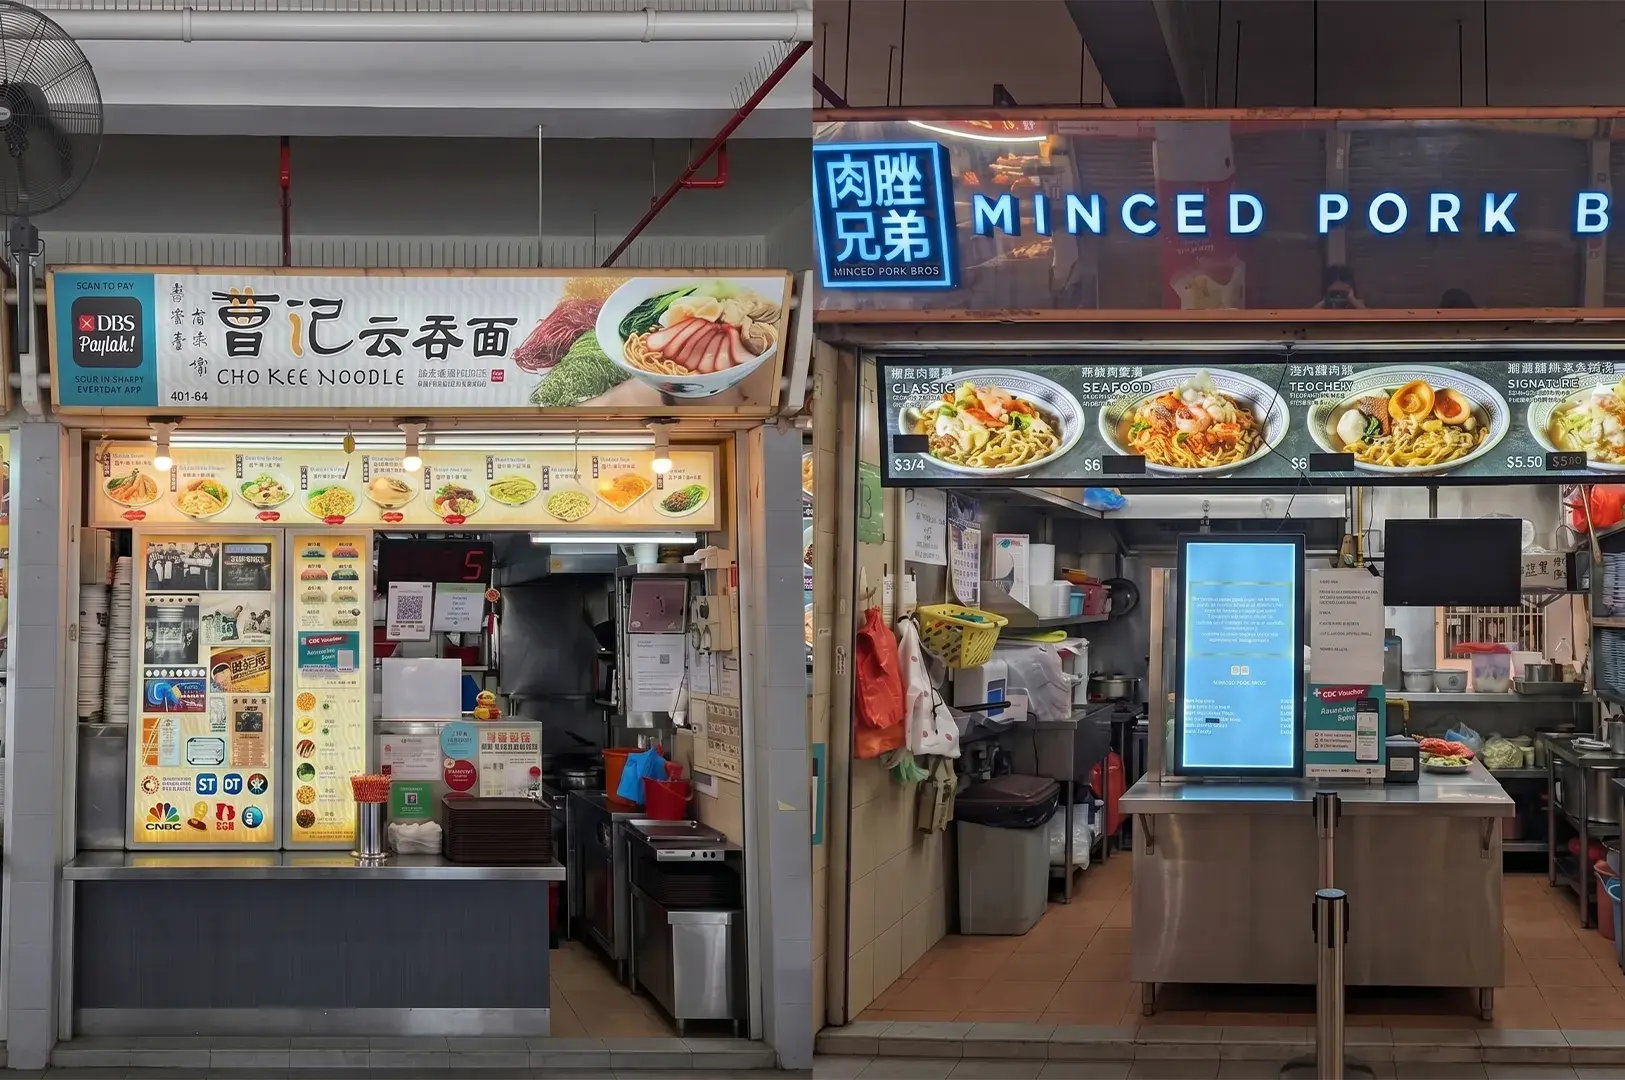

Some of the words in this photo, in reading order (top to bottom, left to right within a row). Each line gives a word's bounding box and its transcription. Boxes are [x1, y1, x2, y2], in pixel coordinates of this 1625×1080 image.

[827, 152, 925, 208] 肉脞
[973, 193, 1264, 235] MINCED
[1318, 192, 1518, 234] PORK
[1576, 192, 1609, 233] B
[836, 209, 930, 262] 兄弟
[834, 267, 875, 276] MINCED
[879, 266, 907, 276] PORK
[911, 266, 939, 276] BROS
[76, 282, 100, 290] SCAN
[103, 282, 115, 290] TO
[117, 282, 135, 290] PAY
[97, 314, 135, 332] DBS
[211, 287, 518, 358] 曹记云吞面
[217, 369, 260, 385] CHO
[268, 368, 308, 385] KEE
[318, 369, 405, 385] NOODLE
[892, 383, 954, 394] CLASSIC
[1082, 382, 1152, 393] SEAFOOD
[171, 391, 208, 401] 401-64
[894, 459, 925, 473] $3/4
[1084, 459, 1100, 472] $6
[1291, 457, 1308, 470] $6
[1507, 456, 1543, 469] $5.50
[463, 550, 484, 580] 5
[1322, 690, 1337, 698] CDC
[199, 778, 216, 792] ST
[224, 778, 240, 791] DT
